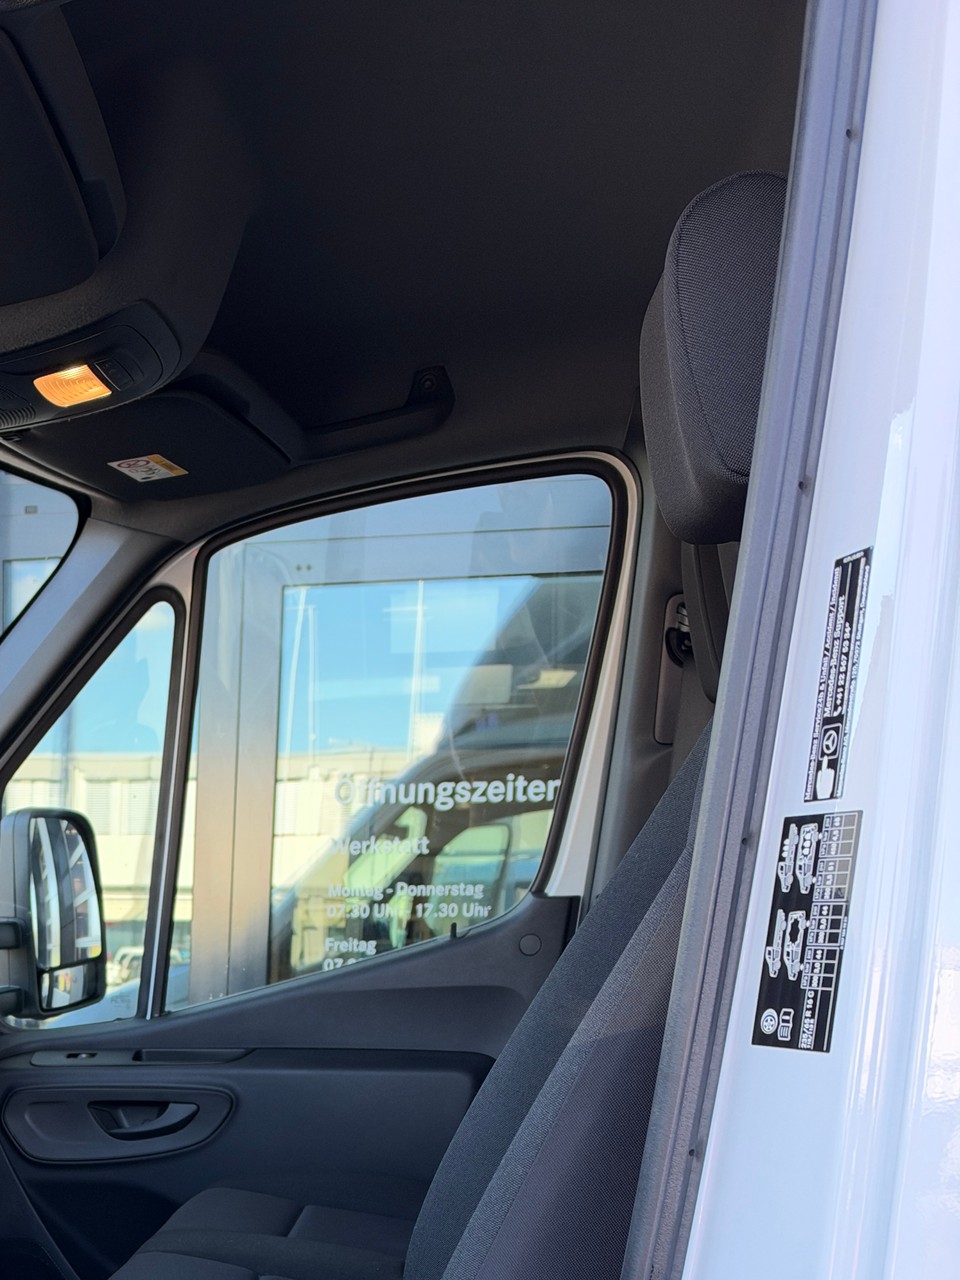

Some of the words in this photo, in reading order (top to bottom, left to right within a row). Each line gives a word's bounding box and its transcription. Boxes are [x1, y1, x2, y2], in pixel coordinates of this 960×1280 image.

[823, 638, 839, 716] Mercedes-Benz
[833, 594, 846, 637] Support
[333, 835, 430, 855] Werkstatt
[328, 884, 384, 900] Montag
[396, 882, 484, 899] Donnerstag
[416, 902, 459, 918] 17.30
[462, 902, 492, 918] Uhr
[325, 937, 377, 956] Freitag
[806, 999, 814, 1009] 16
